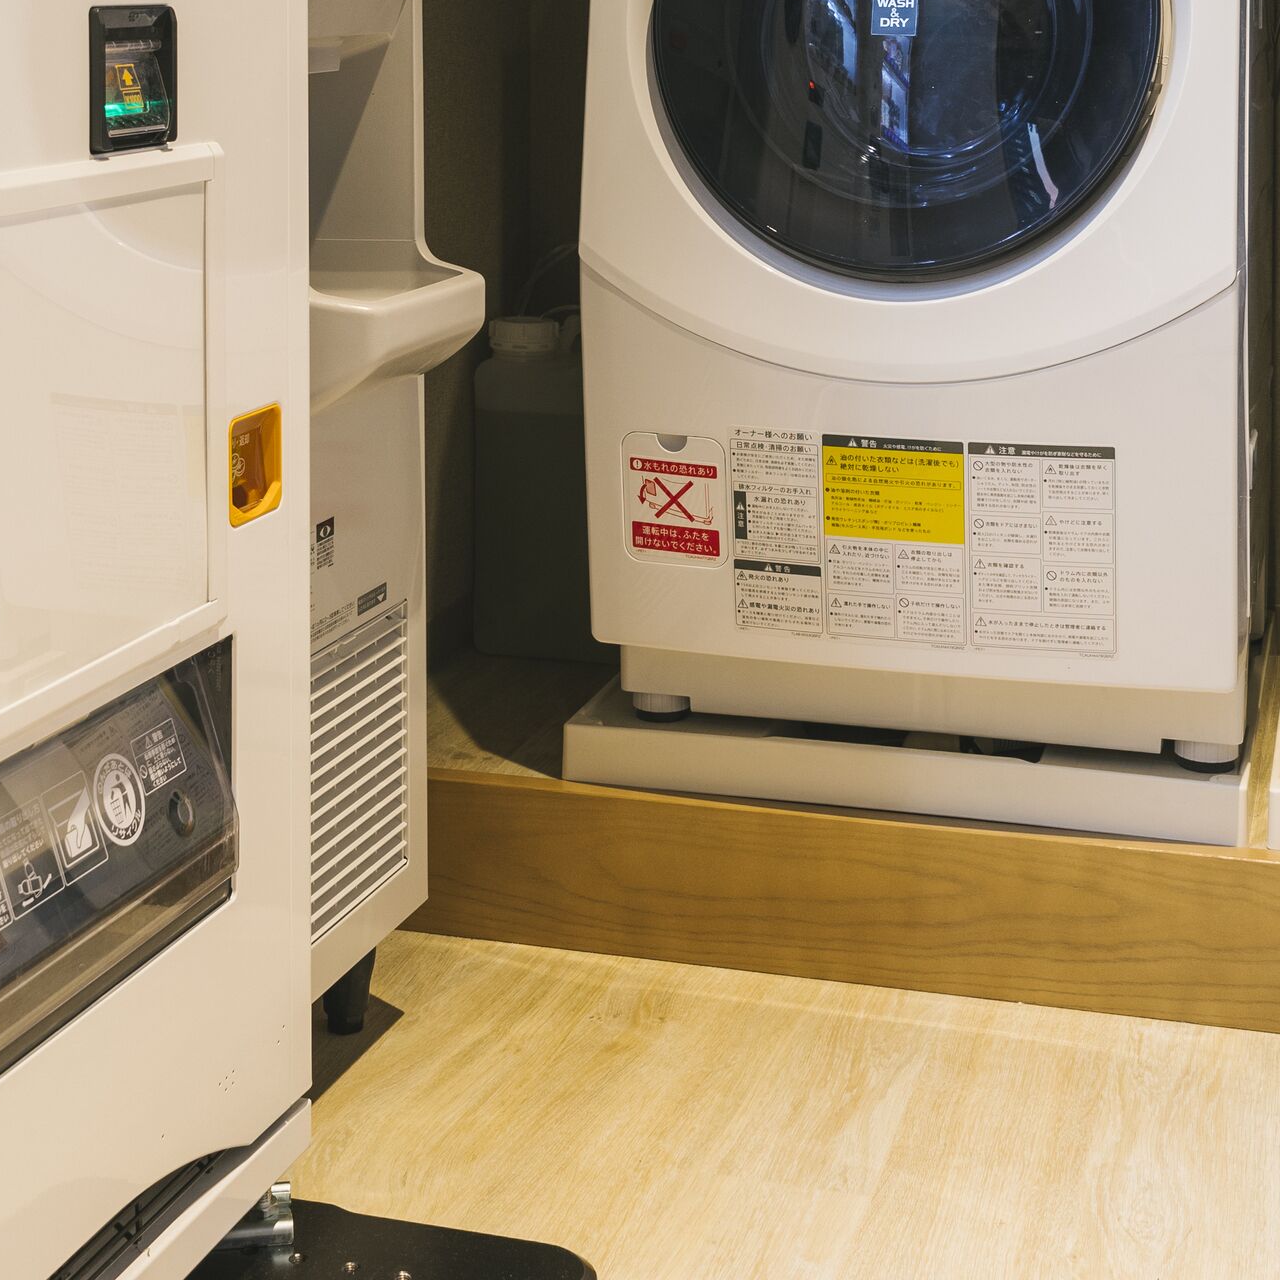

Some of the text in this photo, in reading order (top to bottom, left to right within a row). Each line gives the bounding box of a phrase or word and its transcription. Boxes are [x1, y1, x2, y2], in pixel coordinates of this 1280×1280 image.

[890, 7, 900, 18] &
[880, 17, 910, 27] DRY
[734, 429, 813, 441] オーナー様へのお願い
[736, 441, 812, 453] 日常点検・清掃のお願い
[861, 439, 877, 448] 警告
[999, 446, 1016, 455] 注意
[840, 454, 960, 468] 油の付いた衣類などは(洗濯後でも)
[643, 461, 714, 476] 水もれの恐れあり
[840, 463, 900, 473] 絶対に乾燥しない
[738, 483, 812, 495] 排水フィルターのお手入れ
[754, 496, 806, 506] 水漏れの恐れあり
[642, 525, 709, 542] 運転中は、ふたを
[635, 535, 716, 553] 開けないでください。
[748, 573, 789, 583] 発火の恐れあり
[111, 807, 141, 840] リサイクル
